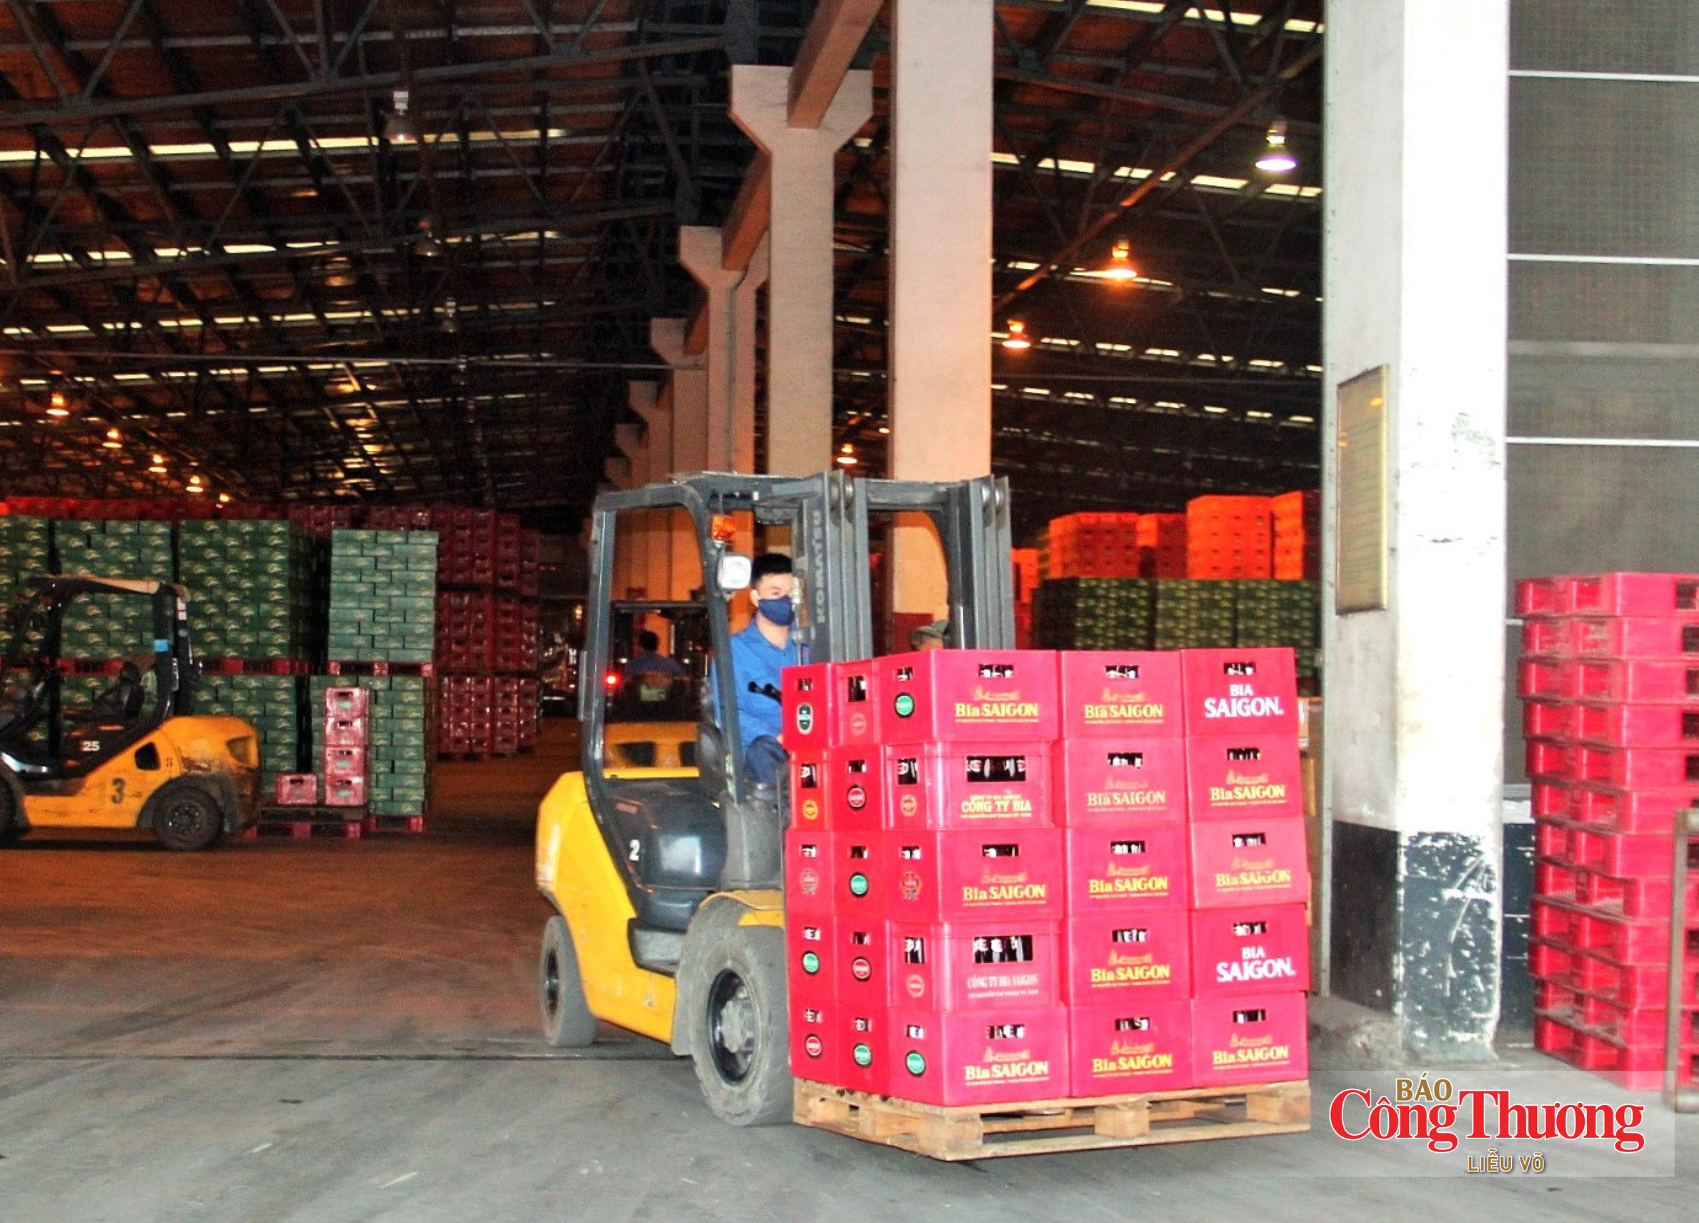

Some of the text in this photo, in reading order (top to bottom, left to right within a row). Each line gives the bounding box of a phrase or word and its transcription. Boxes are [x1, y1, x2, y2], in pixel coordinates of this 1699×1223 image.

[812, 510, 827, 624] KOMATSU
[1229, 684, 1253, 697] BIA
[955, 702, 1039, 718] Bia SAIGON
[1084, 704, 1163, 719] Bia SAIGON
[82, 740, 100, 752] 25
[111, 776, 126, 805] 3
[1088, 791, 1166, 807] Bia SAIGON
[1210, 784, 1285, 801] Bia SAIGON
[995, 800, 1010, 812] TY
[1012, 800, 1032, 812] BIA
[629, 839, 640, 861] 2
[1089, 877, 1168, 893] Bia SAIGON
[1216, 870, 1291, 887] Bia SAIGON
[963, 884, 1046, 901] Bia SAIGON
[1241, 946, 1265, 960] BIA
[1091, 965, 1170, 982] Bia SAIGON
[1093, 1053, 1172, 1073] Bia SAIGON
[1213, 1046, 1289, 1064] Bia SAIGON
[965, 1061, 1049, 1081] Bia SAIGON
